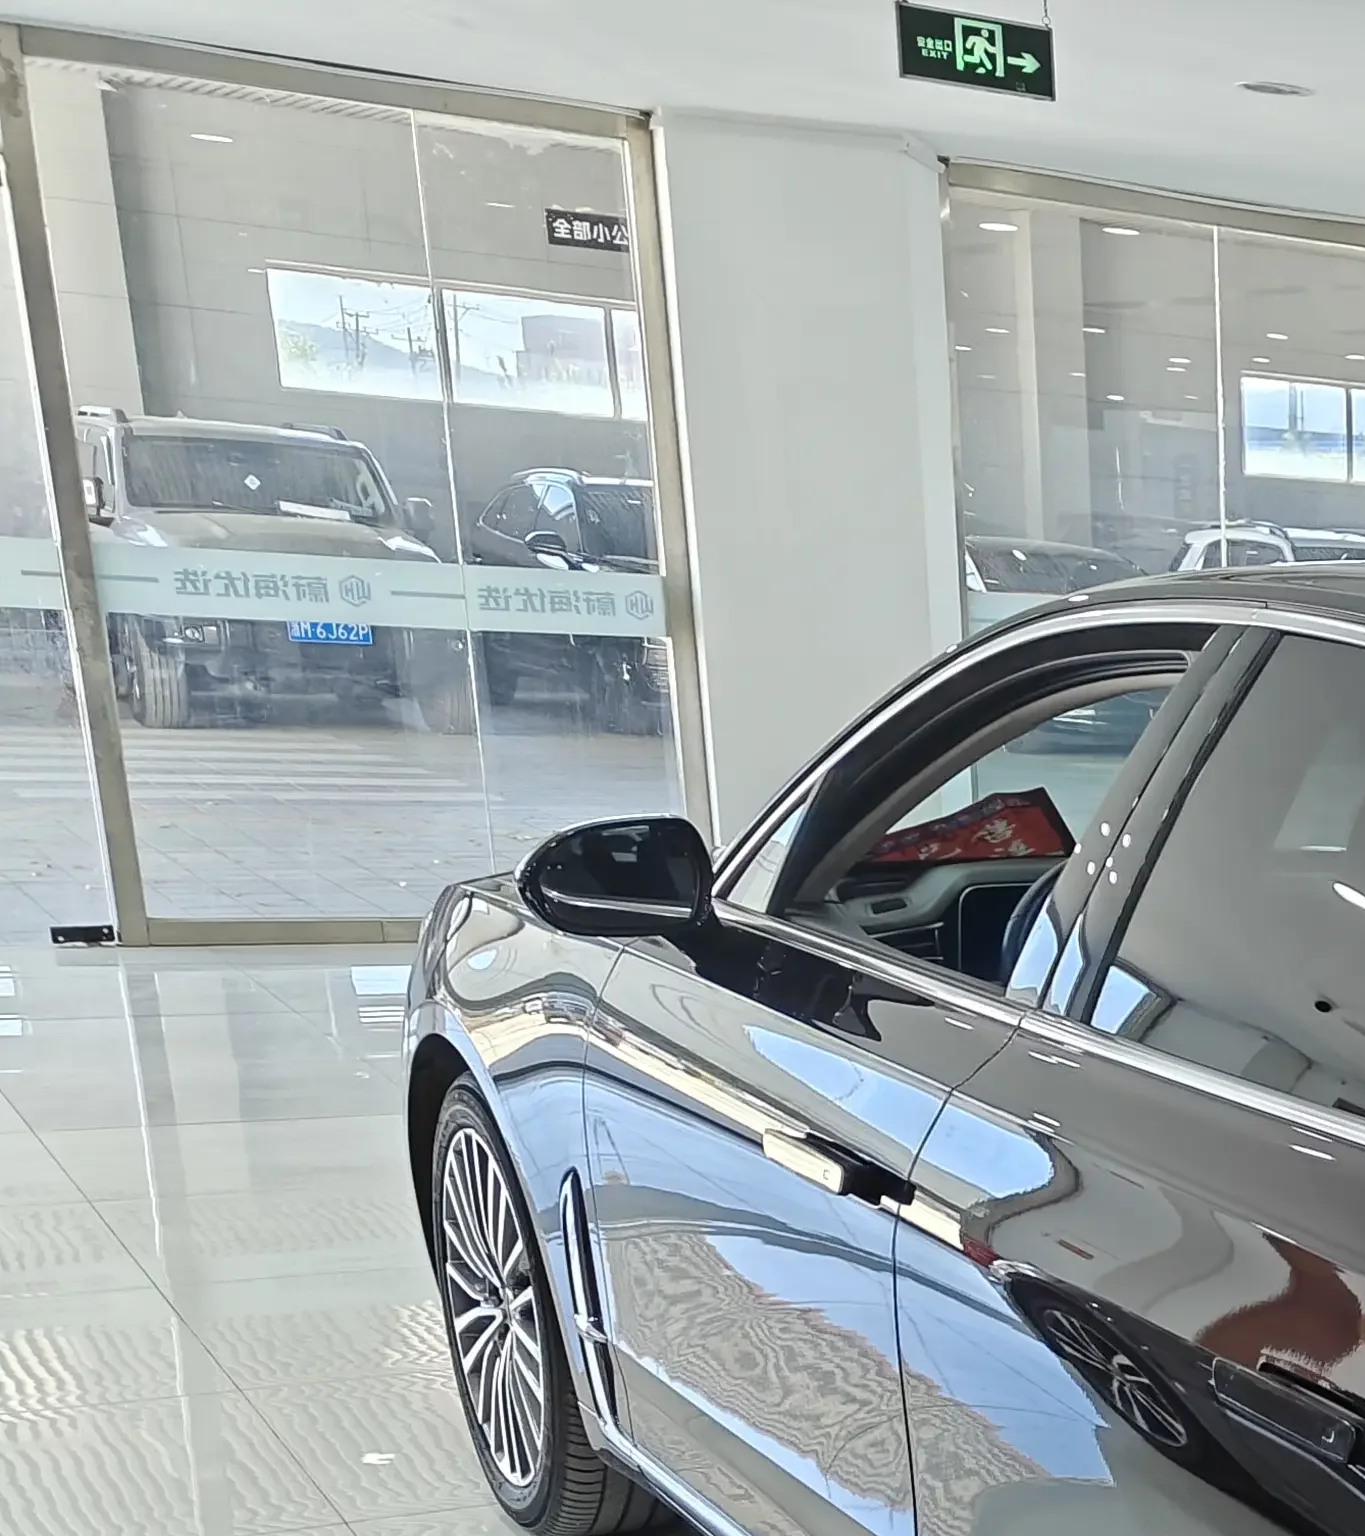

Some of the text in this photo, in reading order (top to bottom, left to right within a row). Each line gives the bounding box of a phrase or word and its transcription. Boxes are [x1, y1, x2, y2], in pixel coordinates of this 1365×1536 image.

[917, 36, 952, 52] 安全出口
[922, 49, 949, 60] EXIT
[552, 218, 628, 245] 全部小公
